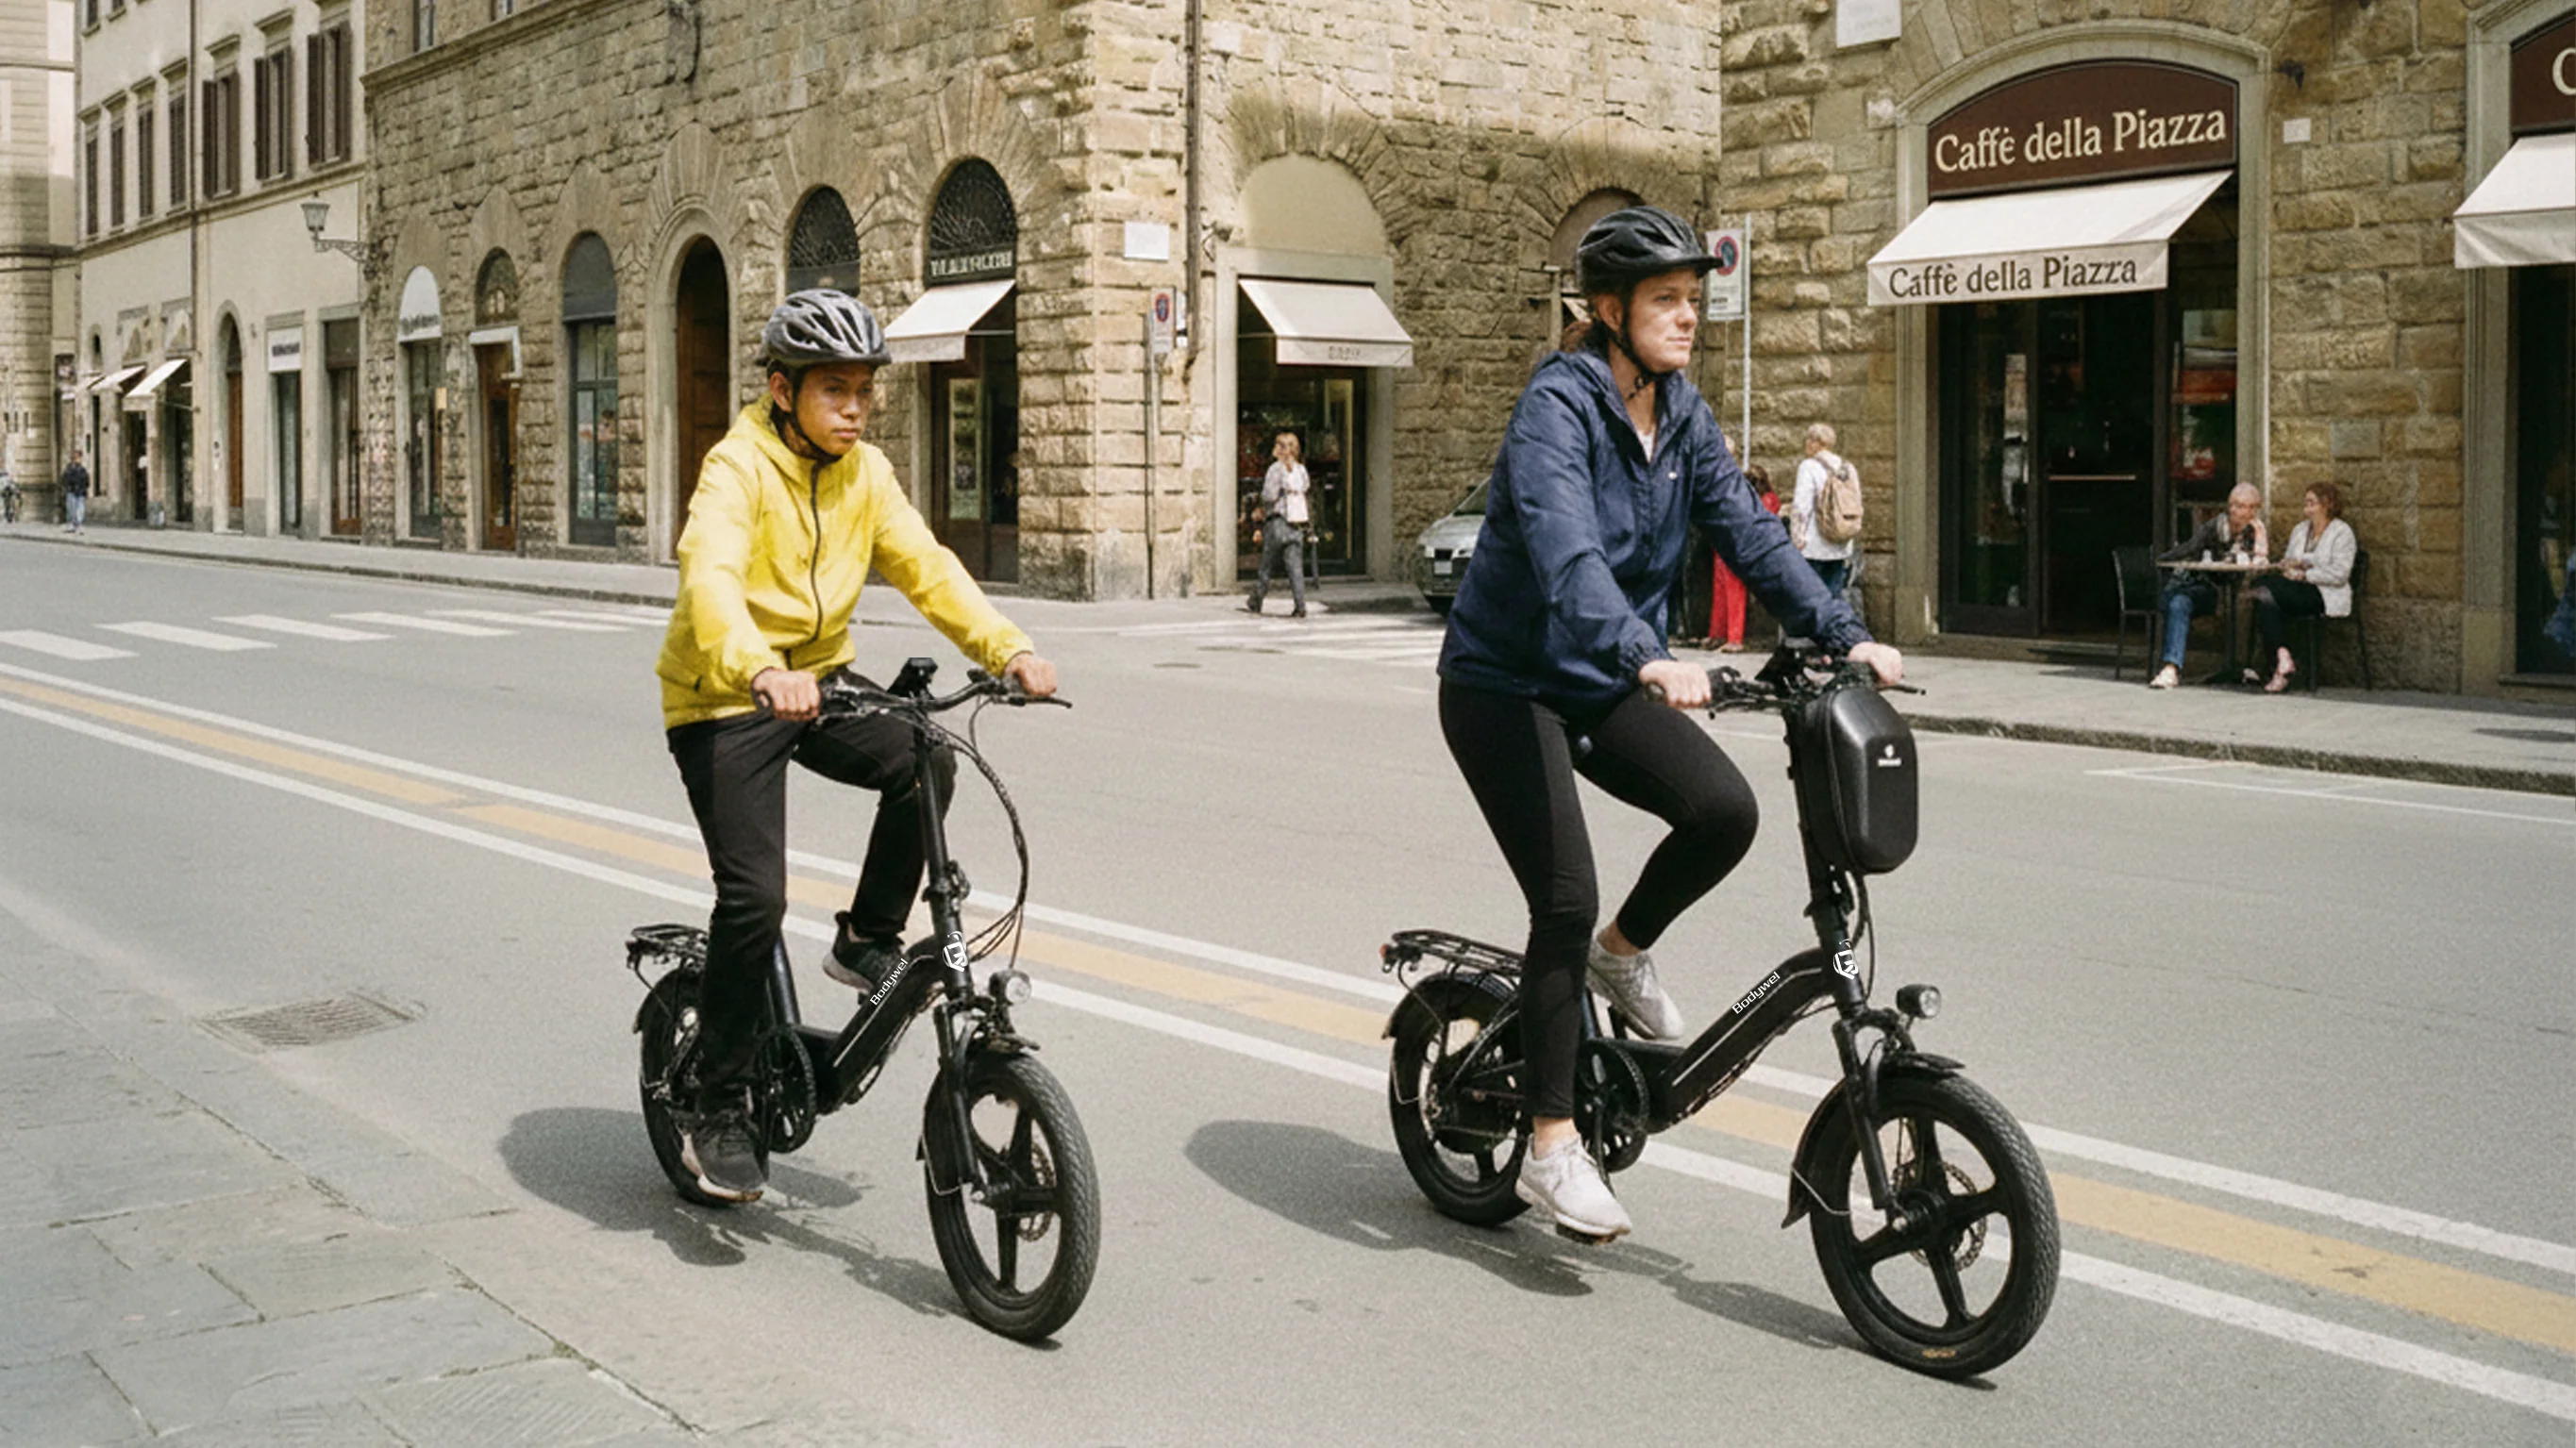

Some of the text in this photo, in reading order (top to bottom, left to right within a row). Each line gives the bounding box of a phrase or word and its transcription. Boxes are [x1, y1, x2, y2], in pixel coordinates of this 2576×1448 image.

[1935, 108, 2227, 173] Caffè della Piazza
[1889, 256, 2137, 298] Caffè della Piazza
[870, 957, 909, 1006] Bodywel
[1731, 971, 1781, 1015] Bodywel
